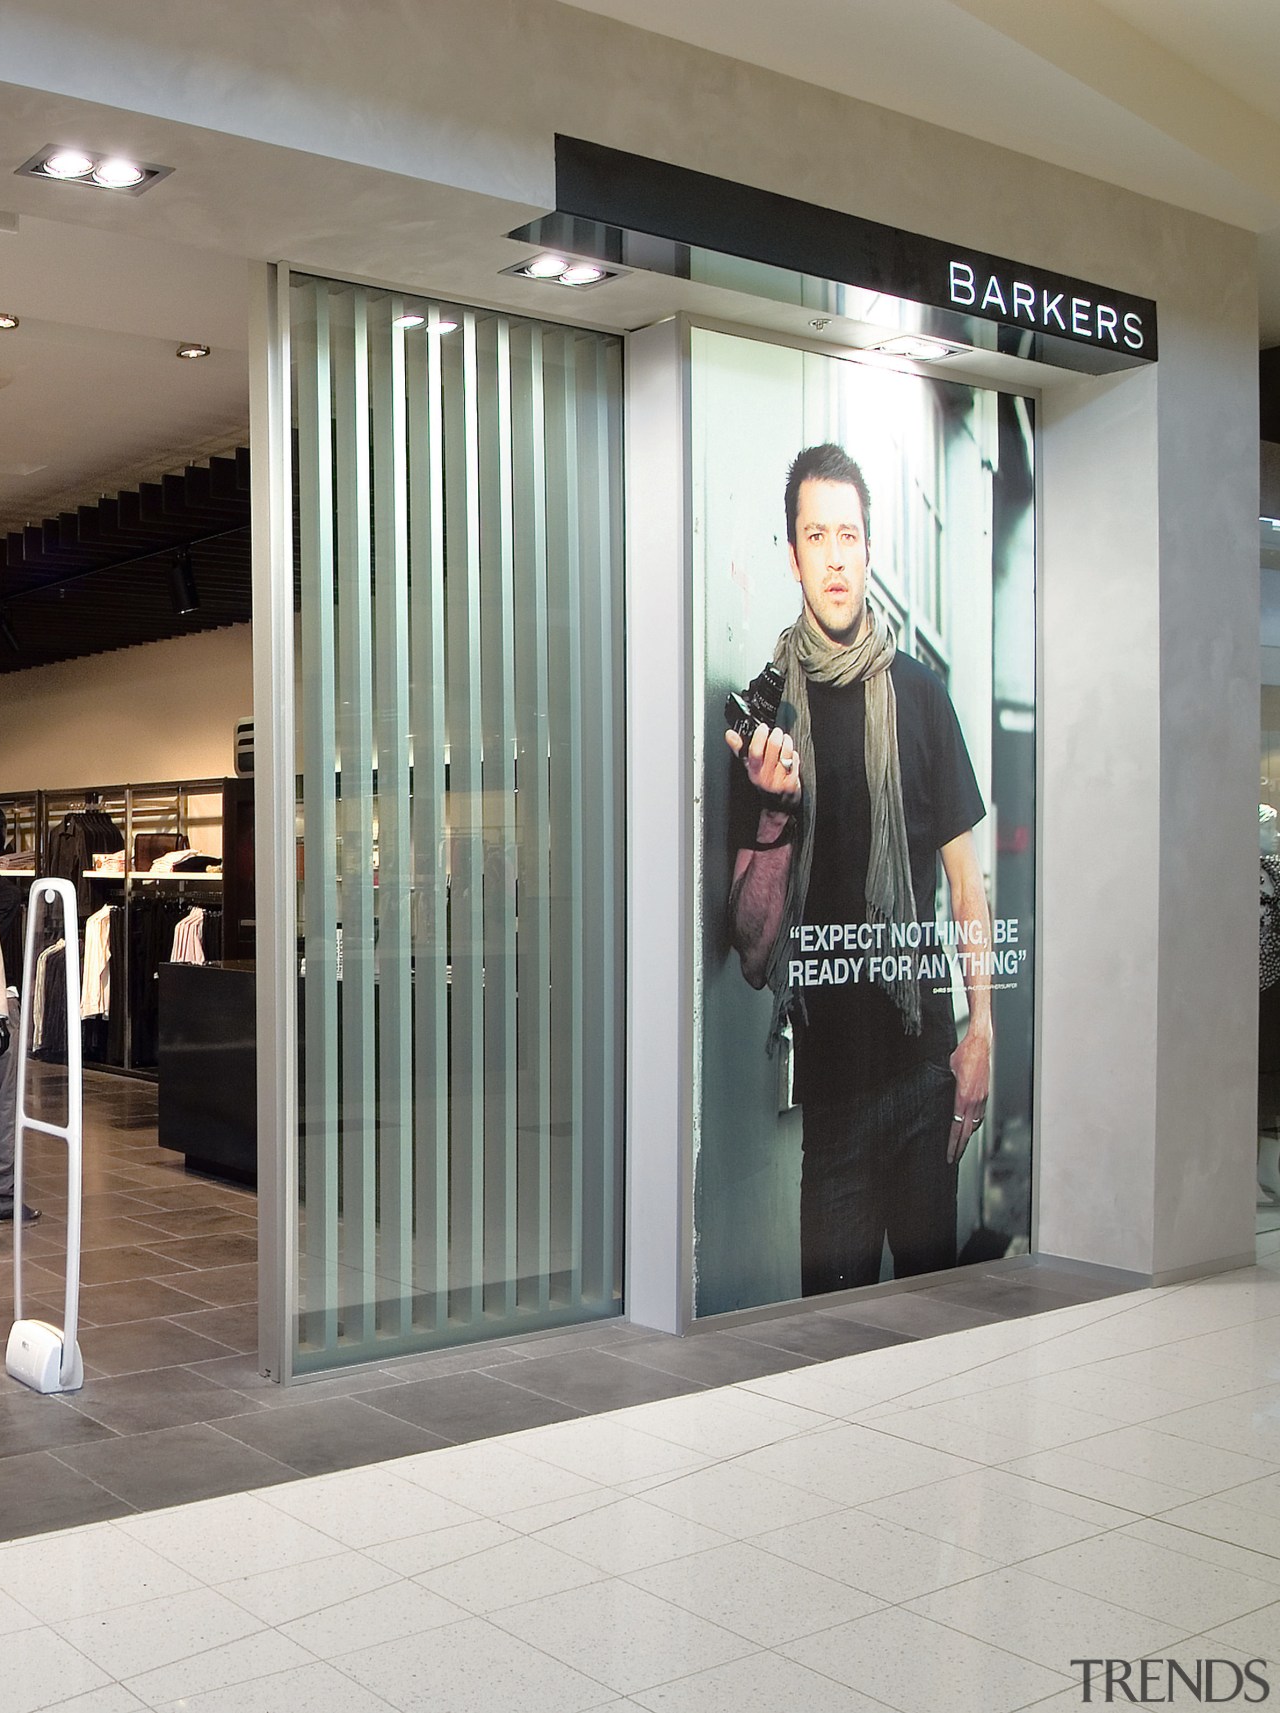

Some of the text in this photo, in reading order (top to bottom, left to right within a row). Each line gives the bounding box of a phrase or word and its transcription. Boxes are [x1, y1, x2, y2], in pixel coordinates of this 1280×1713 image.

[949, 261, 1144, 350] BARKERS
[891, 919, 989, 948] NOTHING,
[993, 918, 1019, 943] BE
[788, 957, 865, 987] READY
[869, 954, 913, 982] FOR
